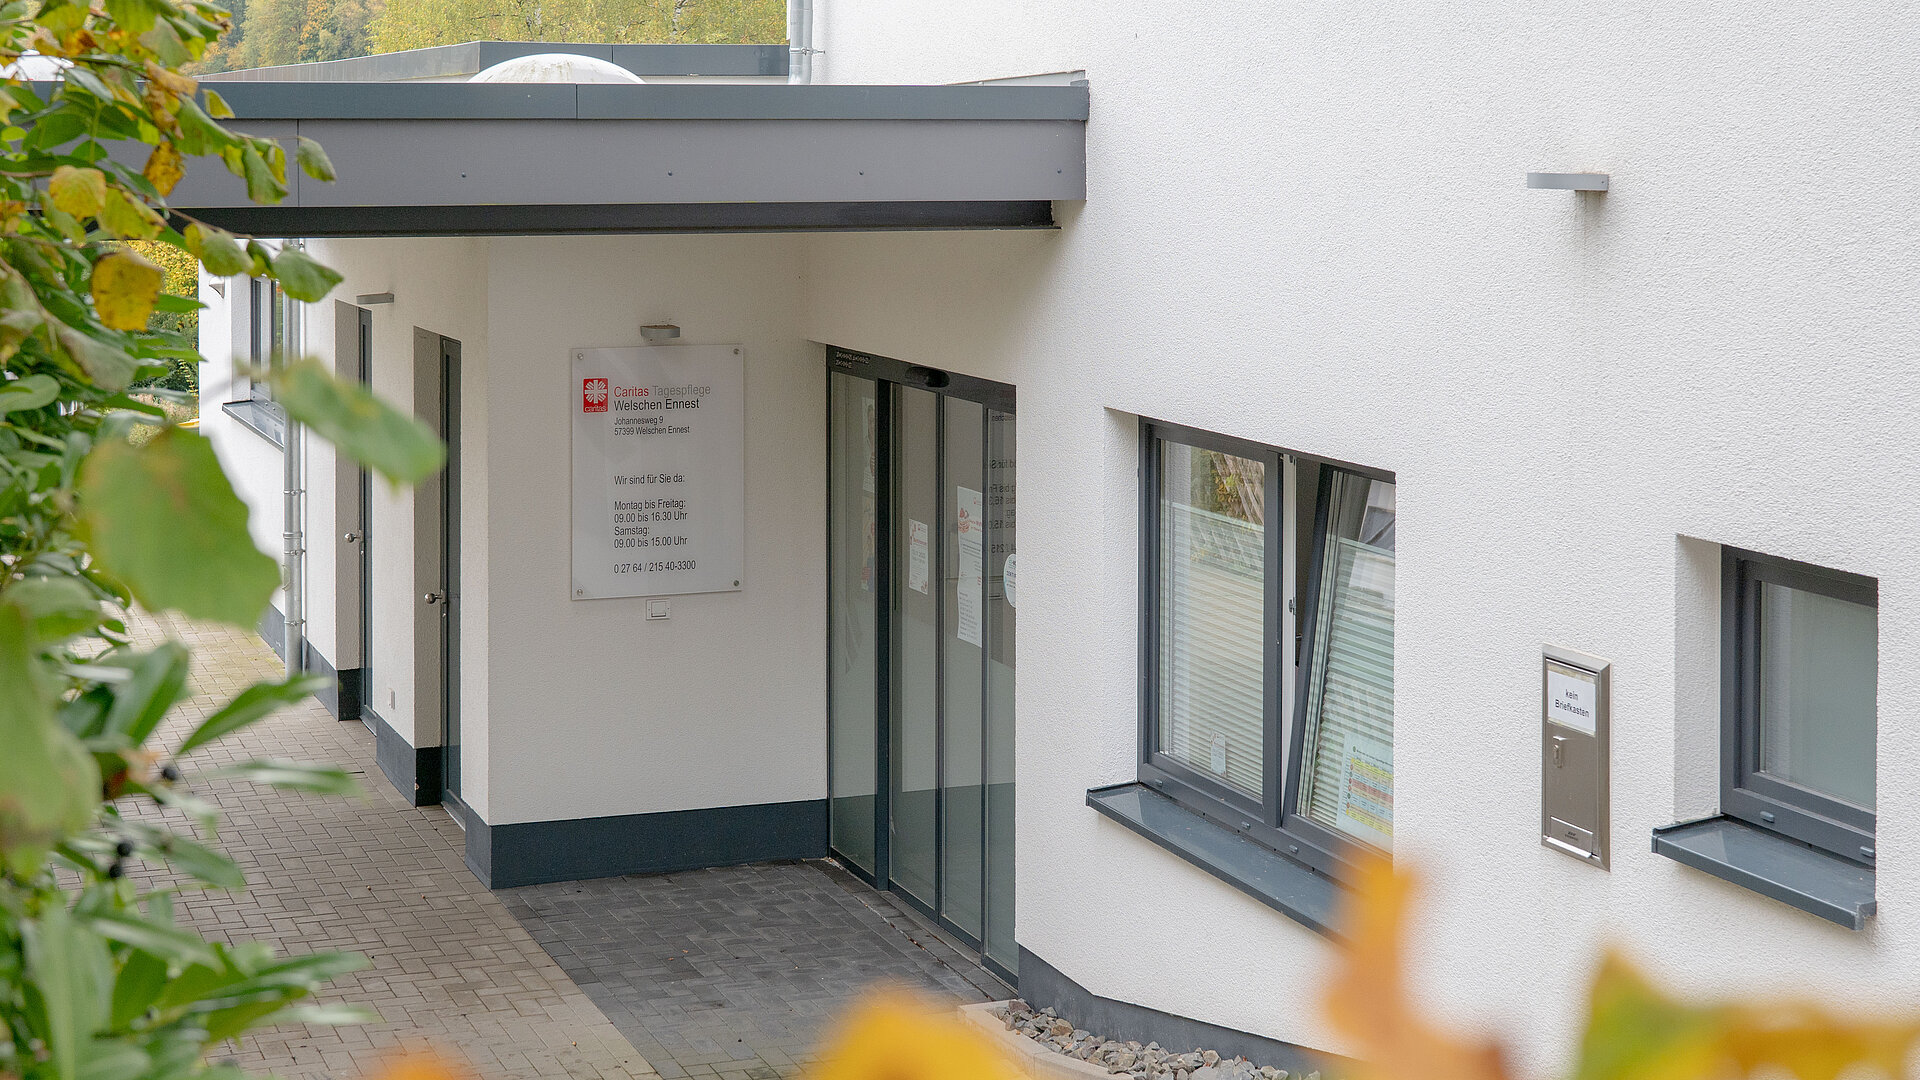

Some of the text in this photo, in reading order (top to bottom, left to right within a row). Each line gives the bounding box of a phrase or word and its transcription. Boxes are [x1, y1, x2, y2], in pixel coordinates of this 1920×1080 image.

[614, 384, 711, 398] Caritas Tagespflege
[614, 398, 700, 411] Welschen Ennest
[614, 415, 664, 426] Johannesweg 9
[614, 425, 690, 436] 57399 Welschen Ennest
[614, 473, 685, 485] Wir sind für Sie da:
[614, 499, 686, 512] Montag bis Freitag:
[614, 511, 688, 523] 09.00 bis 16.30 Uhr
[614, 526, 650, 537] Samstag:
[614, 536, 688, 548] 09.00 bis 15.00 Uhr
[613, 564, 619, 574] 0
[621, 564, 630, 573] 27
[632, 563, 642, 573] 64
[649, 562, 663, 572] 215
[665, 560, 696, 571] 40-3300
[1565, 689, 1578, 701] kein
[1555, 699, 1589, 718] Briefkasten
